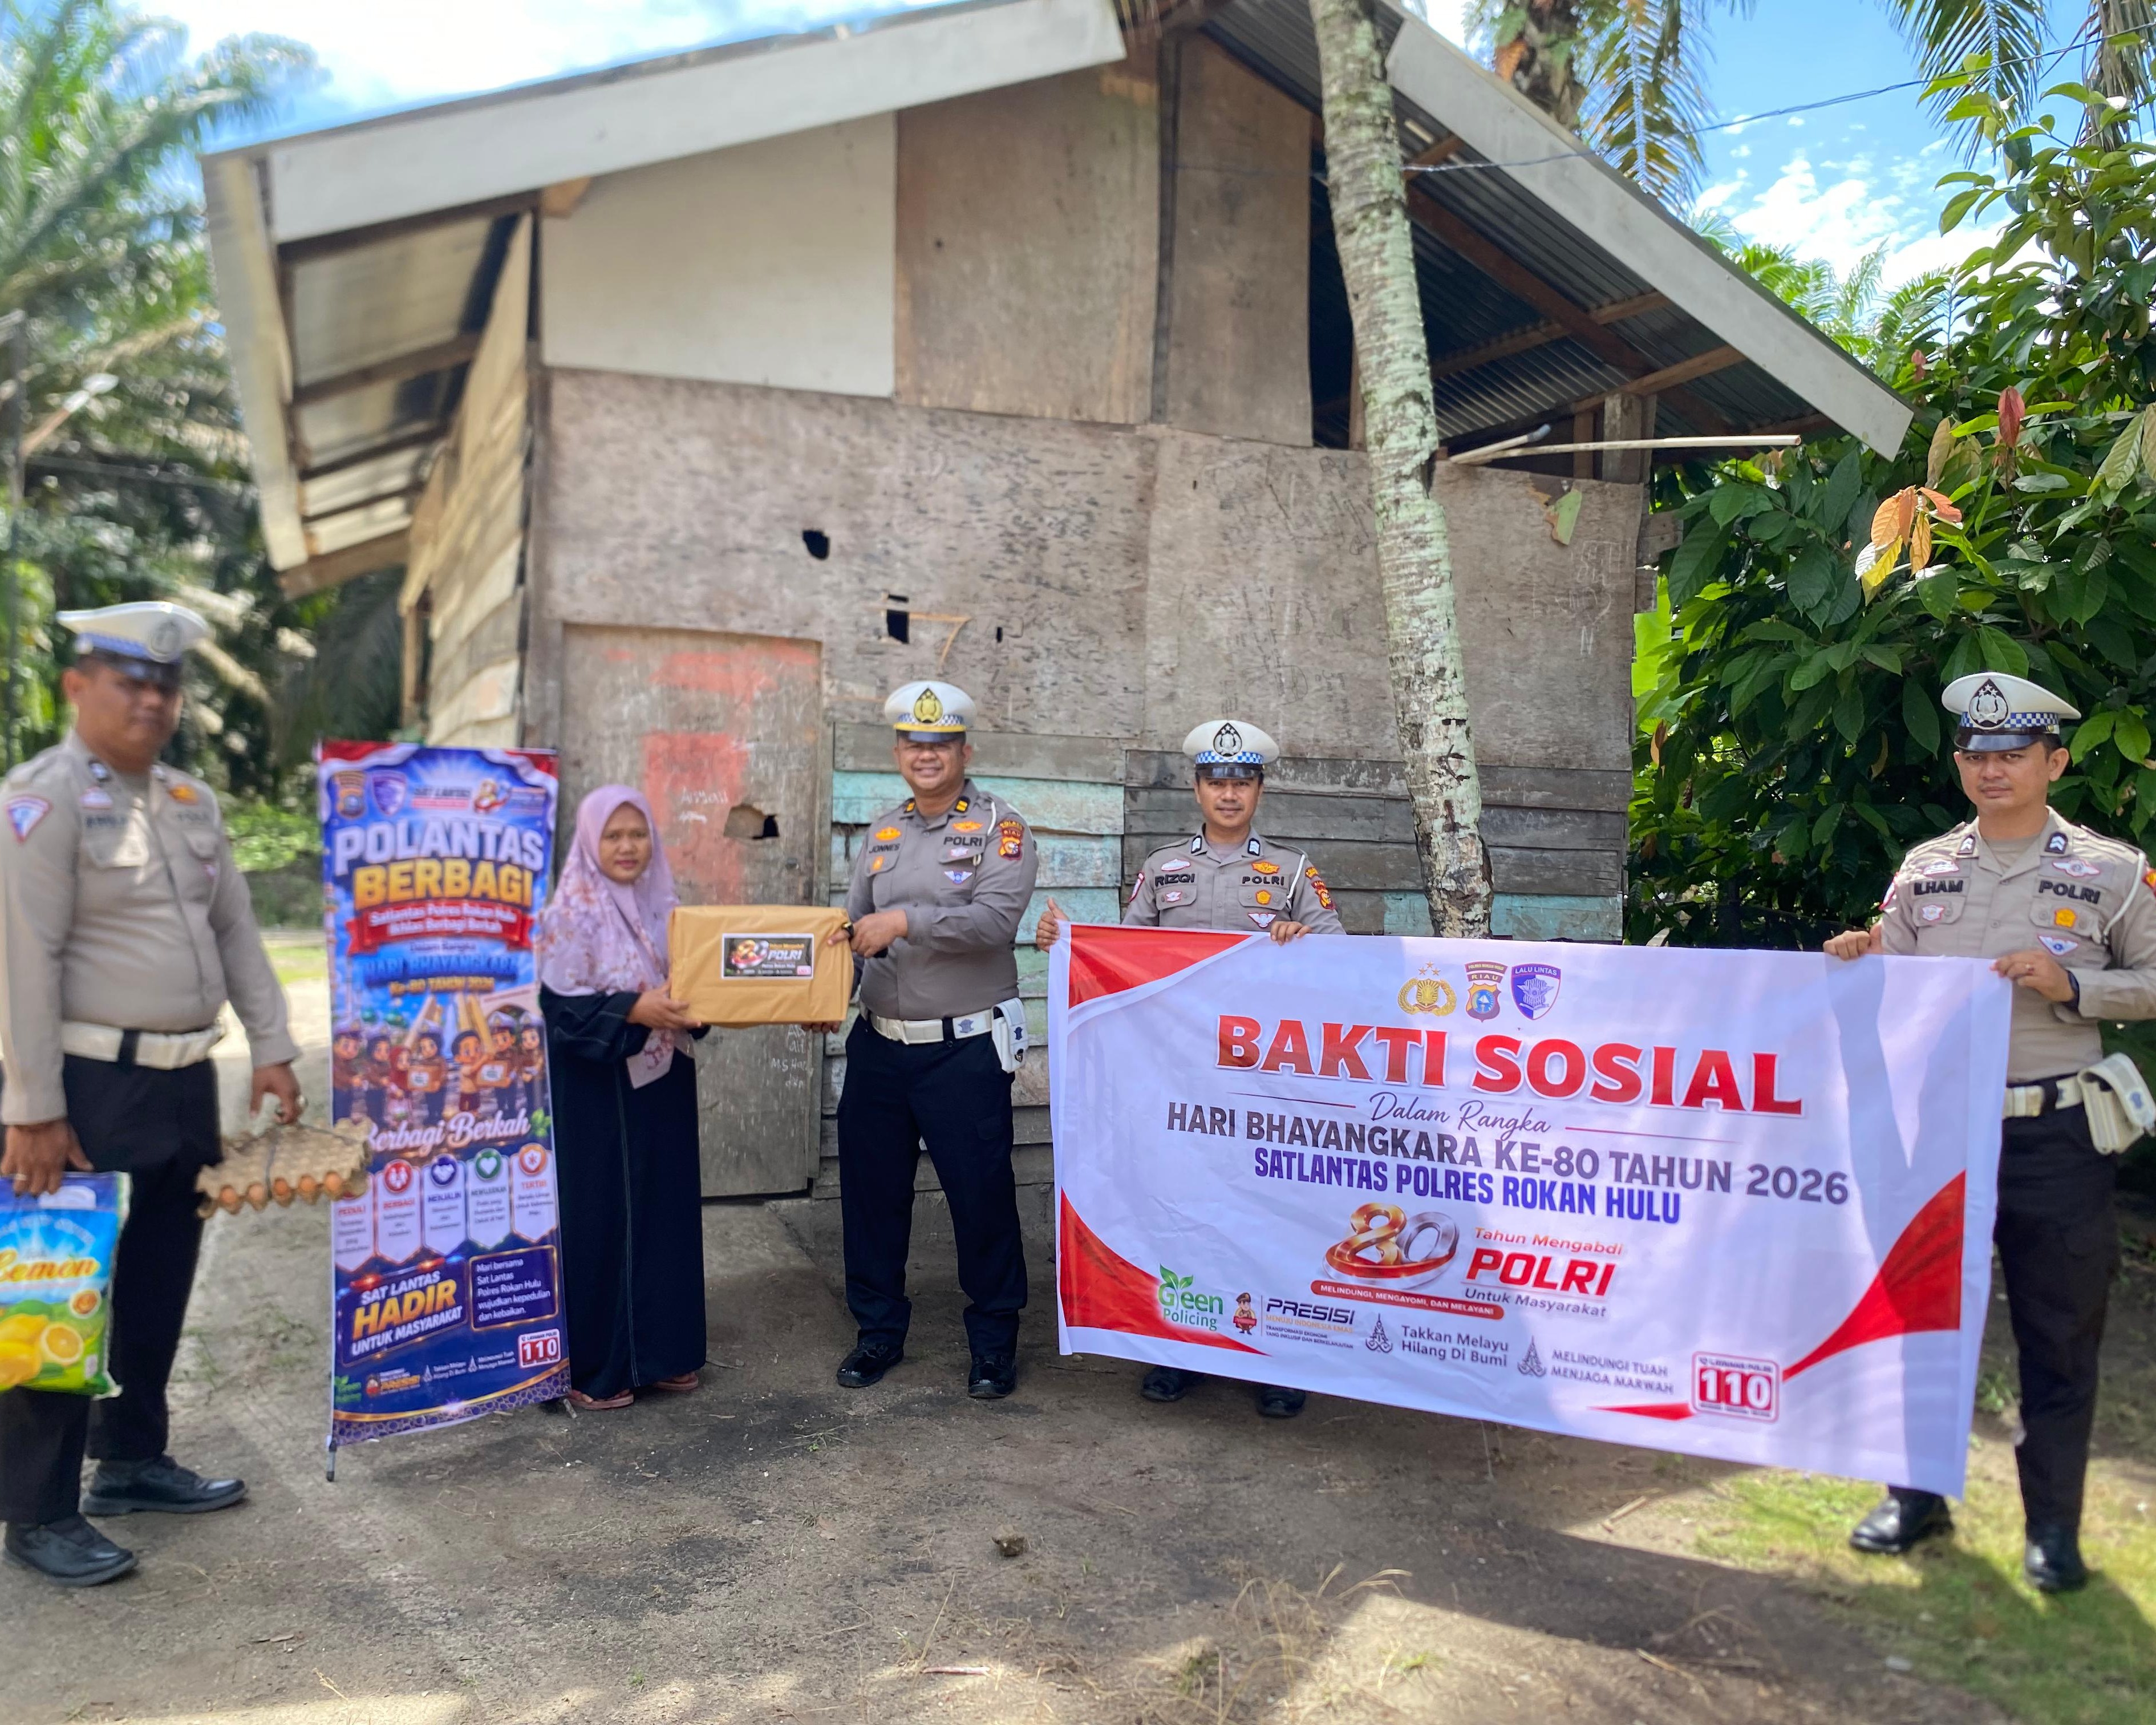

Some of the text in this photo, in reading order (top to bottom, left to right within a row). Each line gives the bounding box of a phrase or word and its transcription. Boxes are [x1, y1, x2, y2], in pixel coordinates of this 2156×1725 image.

[335, 817, 544, 876] POLANTAS
[869, 844, 900, 853] JONNES
[943, 836, 982, 847] POLRI
[354, 859, 533, 910] BERBAGI
[1154, 873, 1195, 886] RIZQI
[1242, 876, 1284, 886] POLRI
[2039, 880, 2101, 904] POLRI
[768, 950, 803, 961] POLRI
[1534, 966, 1557, 975] LINTAS
[1216, 1015, 1803, 1116] BAKTI SOSIAL
[447, 1108, 530, 1148] Berkah
[1369, 1092, 1551, 1141] Dalam Rangka
[1167, 1102, 1849, 1205] HARI BHAYANGKARA KE-80 TAHUN 2026
[1255, 1147, 1681, 1225] SATLANTAS POLRES ROKAN HULU
[1326, 1202, 1460, 1279] 80
[1475, 1227, 1623, 1256] Tahun Mengabdi
[477, 1273, 514, 1285] Sat Lantas
[500, 1283, 523, 1293] Rokan
[524, 1278, 541, 1289] Hulu
[1465, 1247, 1617, 1297] POLRI
[362, 1270, 441, 1305] SAT LANTAS
[1320, 1285, 1373, 1300] MELINDUNGI,
[1430, 1300, 1449, 1310] DAN
[1450, 1303, 1494, 1315] MELAYANI
[352, 1279, 456, 1340] HADIR
[479, 1311, 492, 1322] dan
[1266, 1298, 1356, 1325] PRESISI
[1465, 1287, 1607, 1318] Untuk Masyarakat
[352, 1305, 463, 1356] UNTUK MASYARAKAT
[1162, 1308, 1218, 1331] Policing
[1266, 1314, 1293, 1325] MENUJU
[1295, 1318, 1332, 1330] INDONESIA
[1266, 1325, 1303, 1335] TRANSFORMASI
[524, 1338, 557, 1360] 110
[1401, 1325, 1509, 1354] Takkan Melayu
[1401, 1341, 1507, 1367] Hilang Di Bumi
[1551, 1349, 1669, 1377] MELINDUNGI TUAH
[1550, 1366, 1675, 1395] MENJAGA MARWAH
[1701, 1369, 1770, 1409] 110
